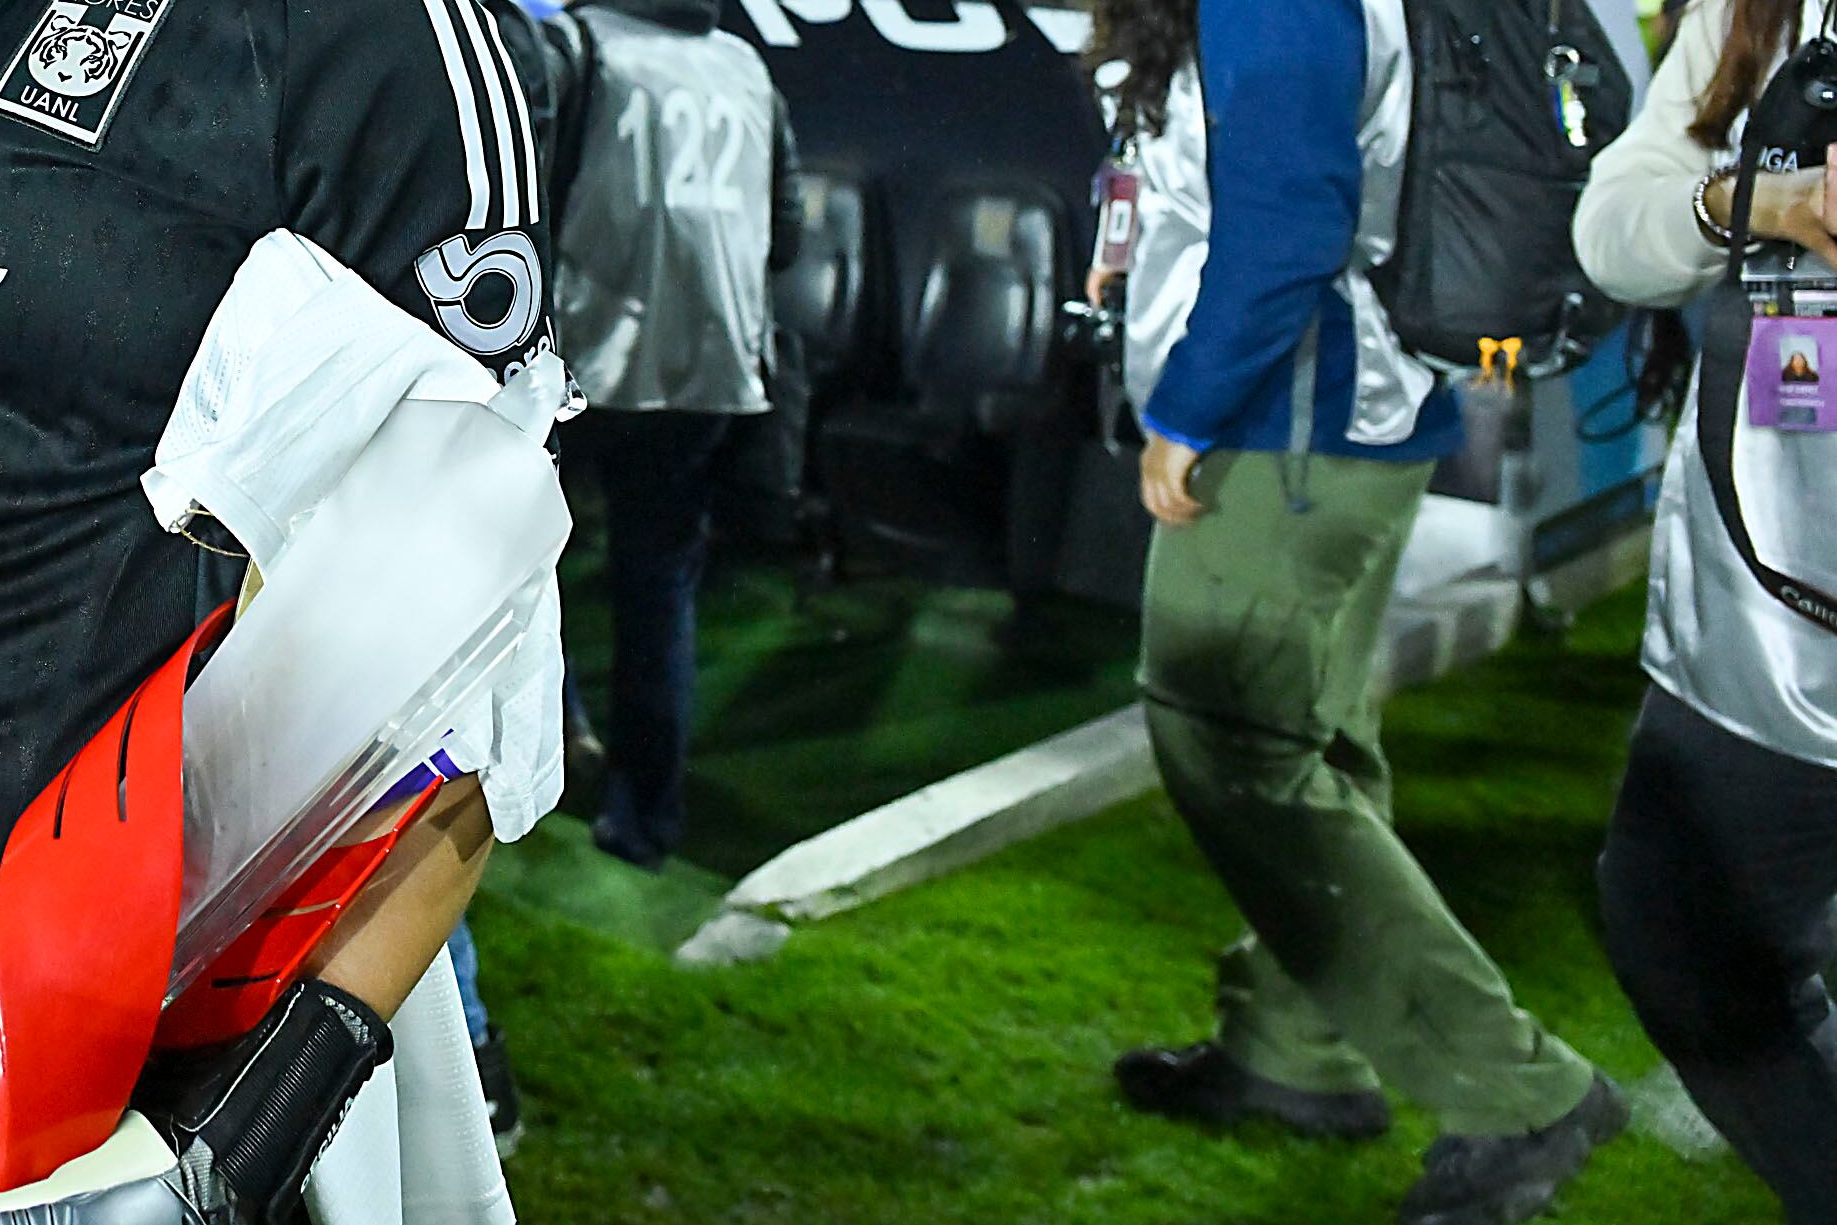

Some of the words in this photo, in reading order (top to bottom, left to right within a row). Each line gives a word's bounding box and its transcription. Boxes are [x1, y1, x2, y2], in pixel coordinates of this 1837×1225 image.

[20, 85, 80, 123] UANL
[617, 87, 744, 210] 122
[1758, 146, 1799, 173] IGA
